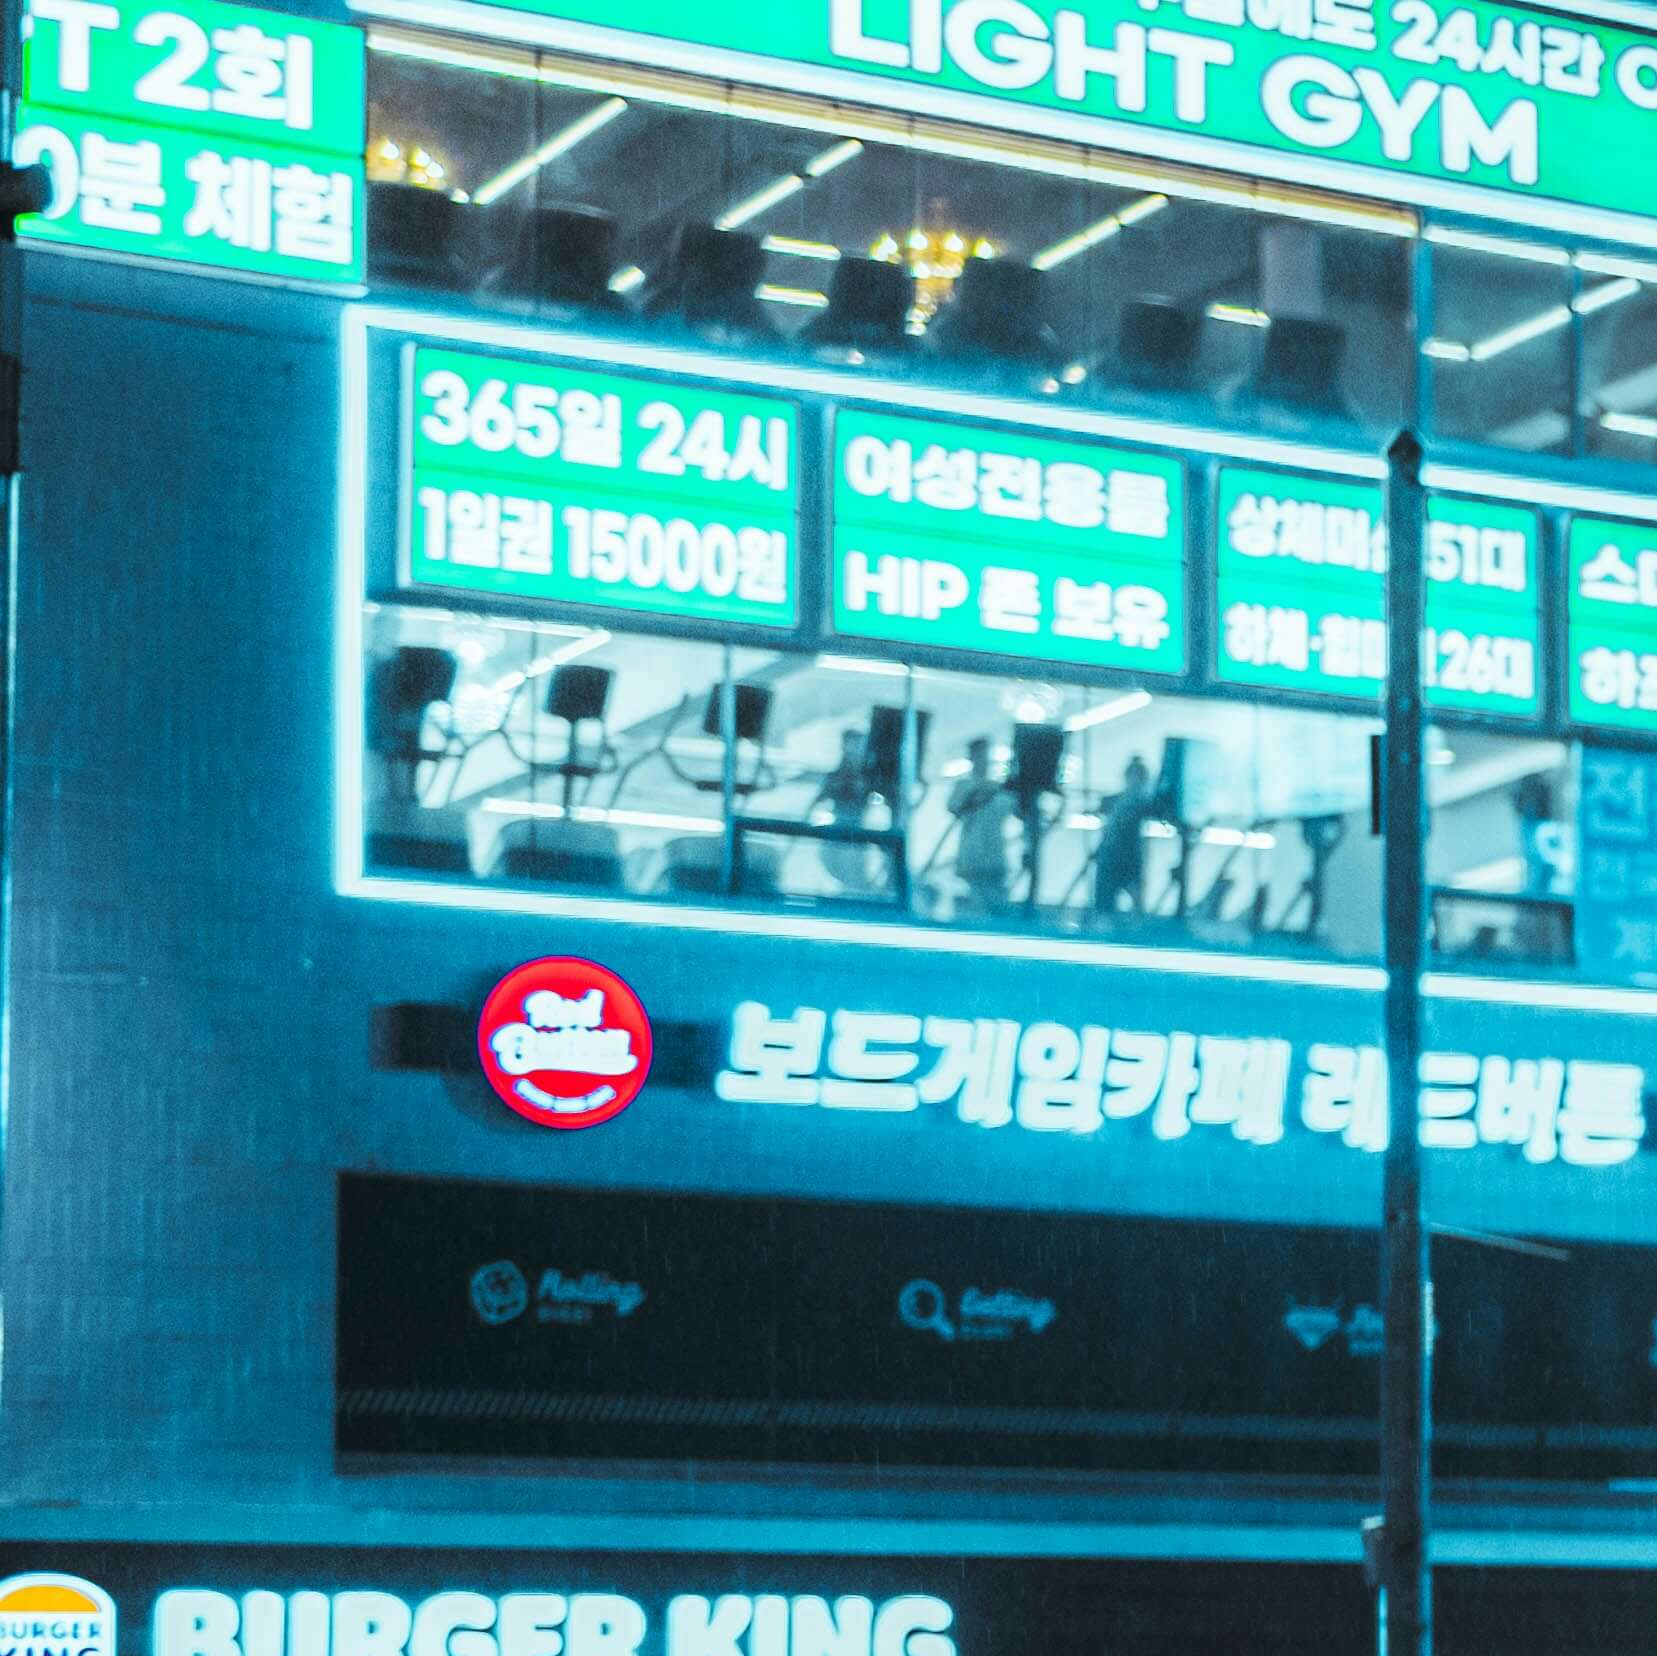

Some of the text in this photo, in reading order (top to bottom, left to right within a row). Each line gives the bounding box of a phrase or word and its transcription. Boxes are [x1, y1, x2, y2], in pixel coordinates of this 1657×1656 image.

[133, 11, 313, 130] 2회
[828, 0, 1541, 187] LIGHT GYM
[1138, 0, 1605, 98] 에도 24시간
[183, 150, 354, 265] 체험
[420, 369, 789, 490] 365일 24시
[562, 505, 788, 604] 15000원
[843, 550, 970, 621] HIP
[1052, 576, 1170, 650] 보유
[715, 1000, 1646, 1165] 보드게임카페 레드버튼
